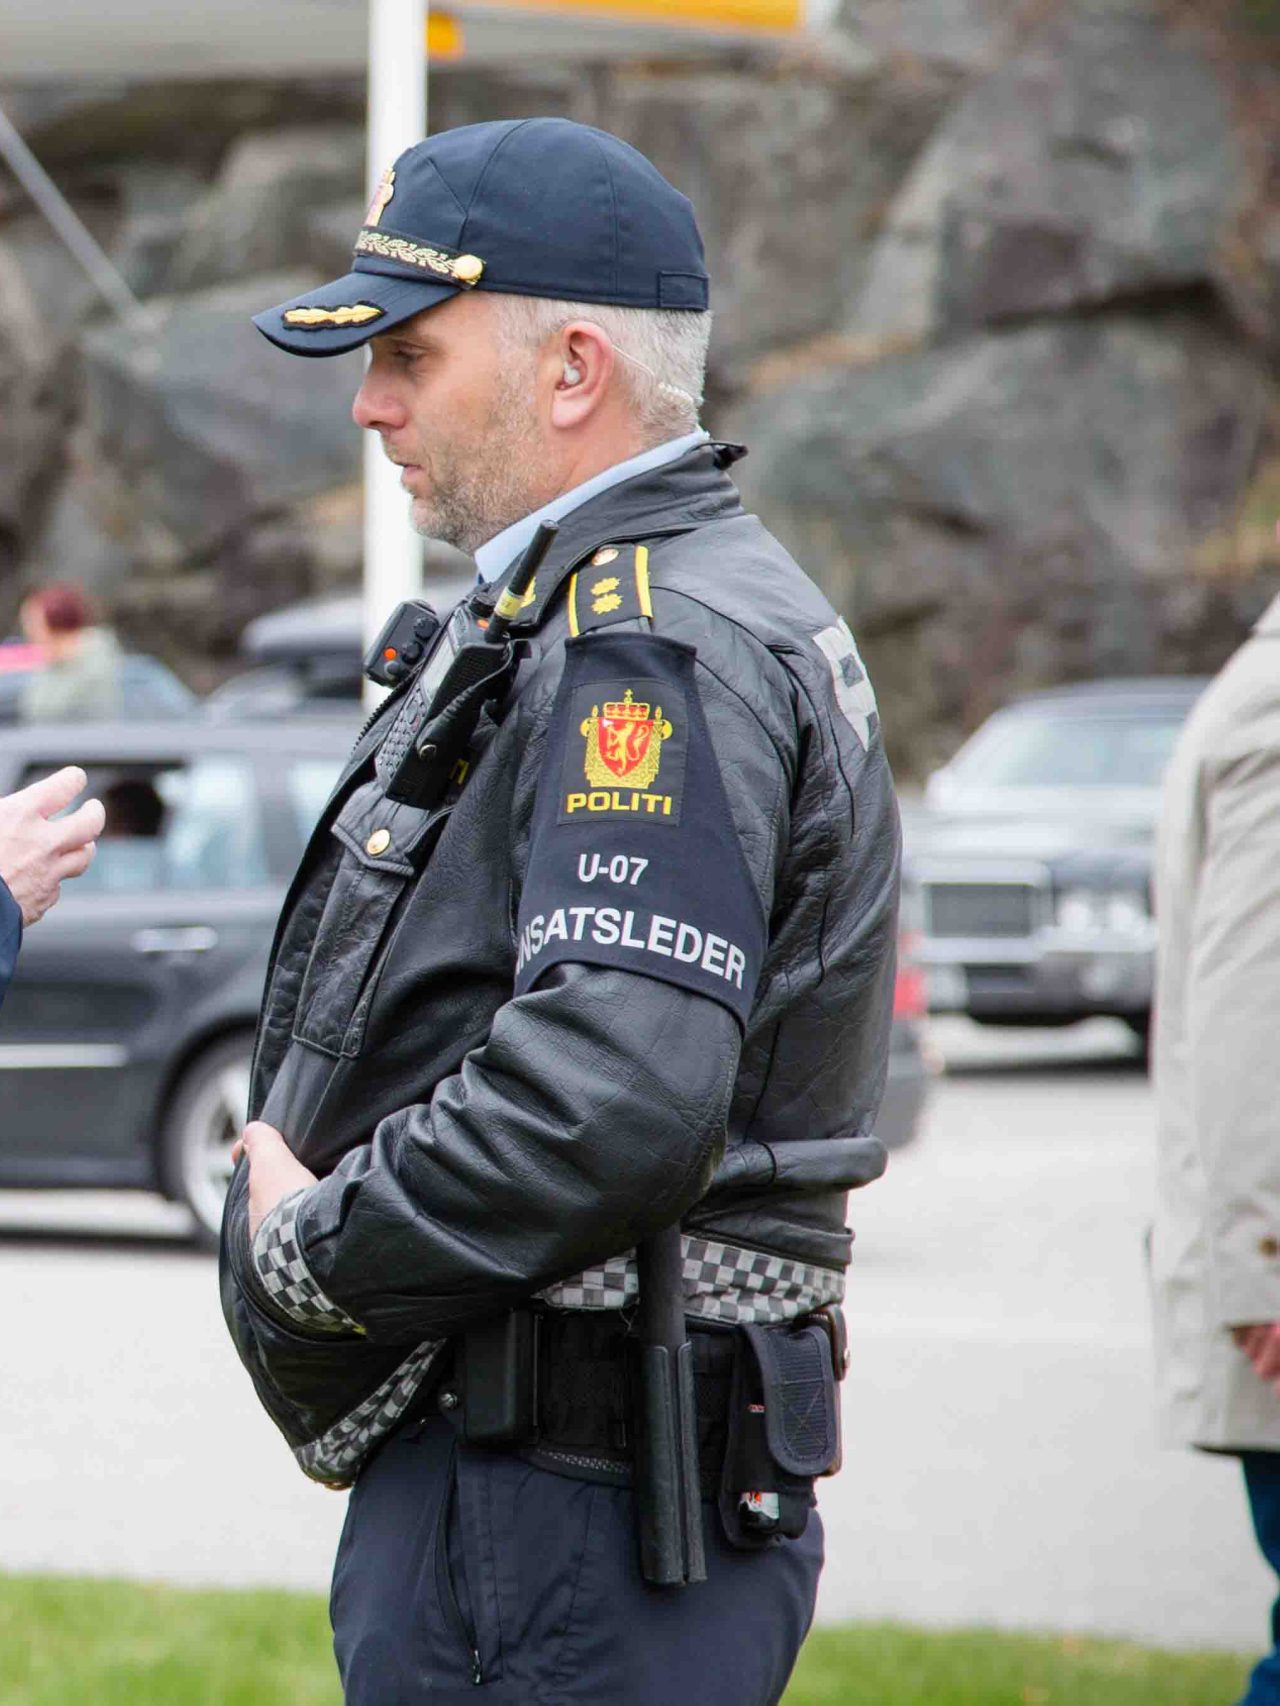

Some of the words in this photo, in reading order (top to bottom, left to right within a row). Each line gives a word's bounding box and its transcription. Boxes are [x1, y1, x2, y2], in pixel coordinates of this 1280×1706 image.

[566, 791, 672, 815] POLITI
[578, 853, 649, 885] U-07
[516, 906, 746, 990] NSATSLEDER
